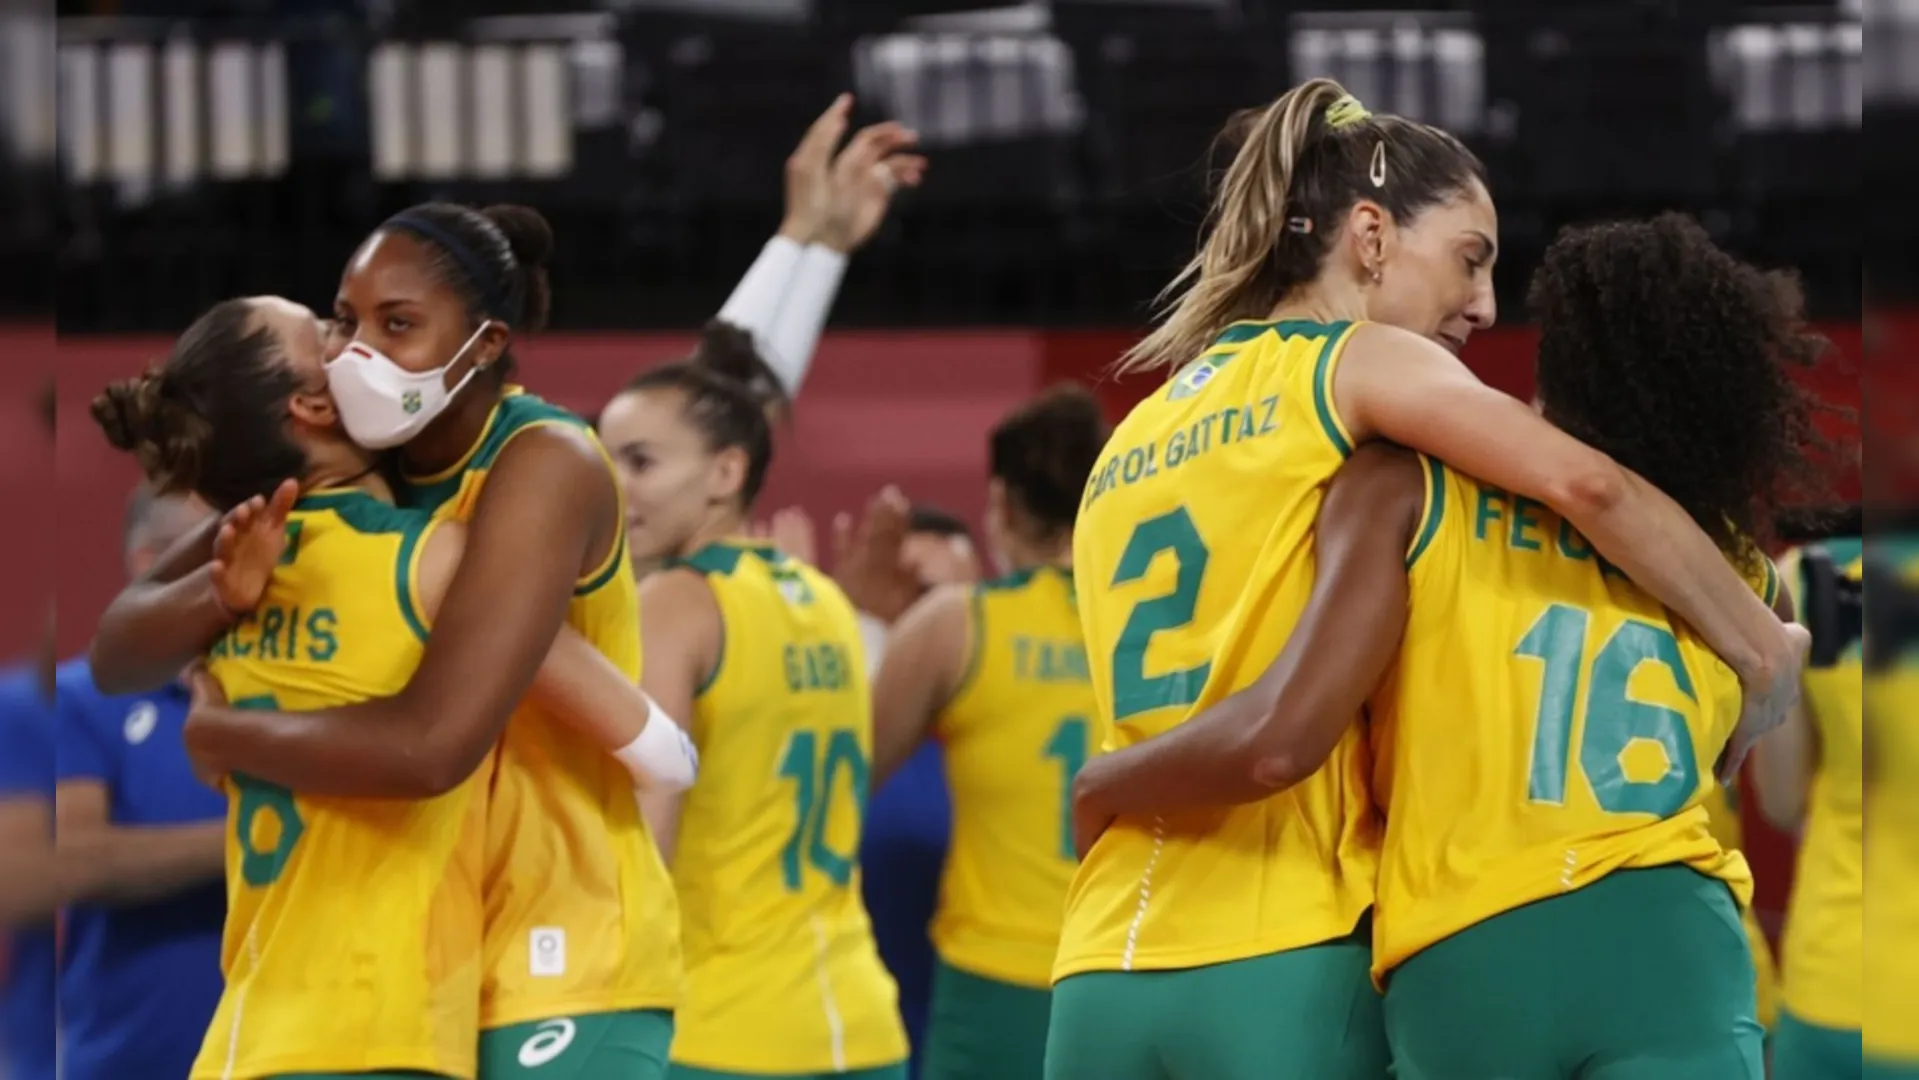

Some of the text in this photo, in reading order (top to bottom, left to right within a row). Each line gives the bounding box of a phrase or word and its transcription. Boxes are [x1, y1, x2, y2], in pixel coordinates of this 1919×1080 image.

[1084, 394, 1280, 512] CAROL GATTAZ
[782, 640, 853, 694] GABI
[1110, 504, 1213, 721] 2
[1513, 602, 1700, 823] 16
[777, 727, 873, 893] 10
